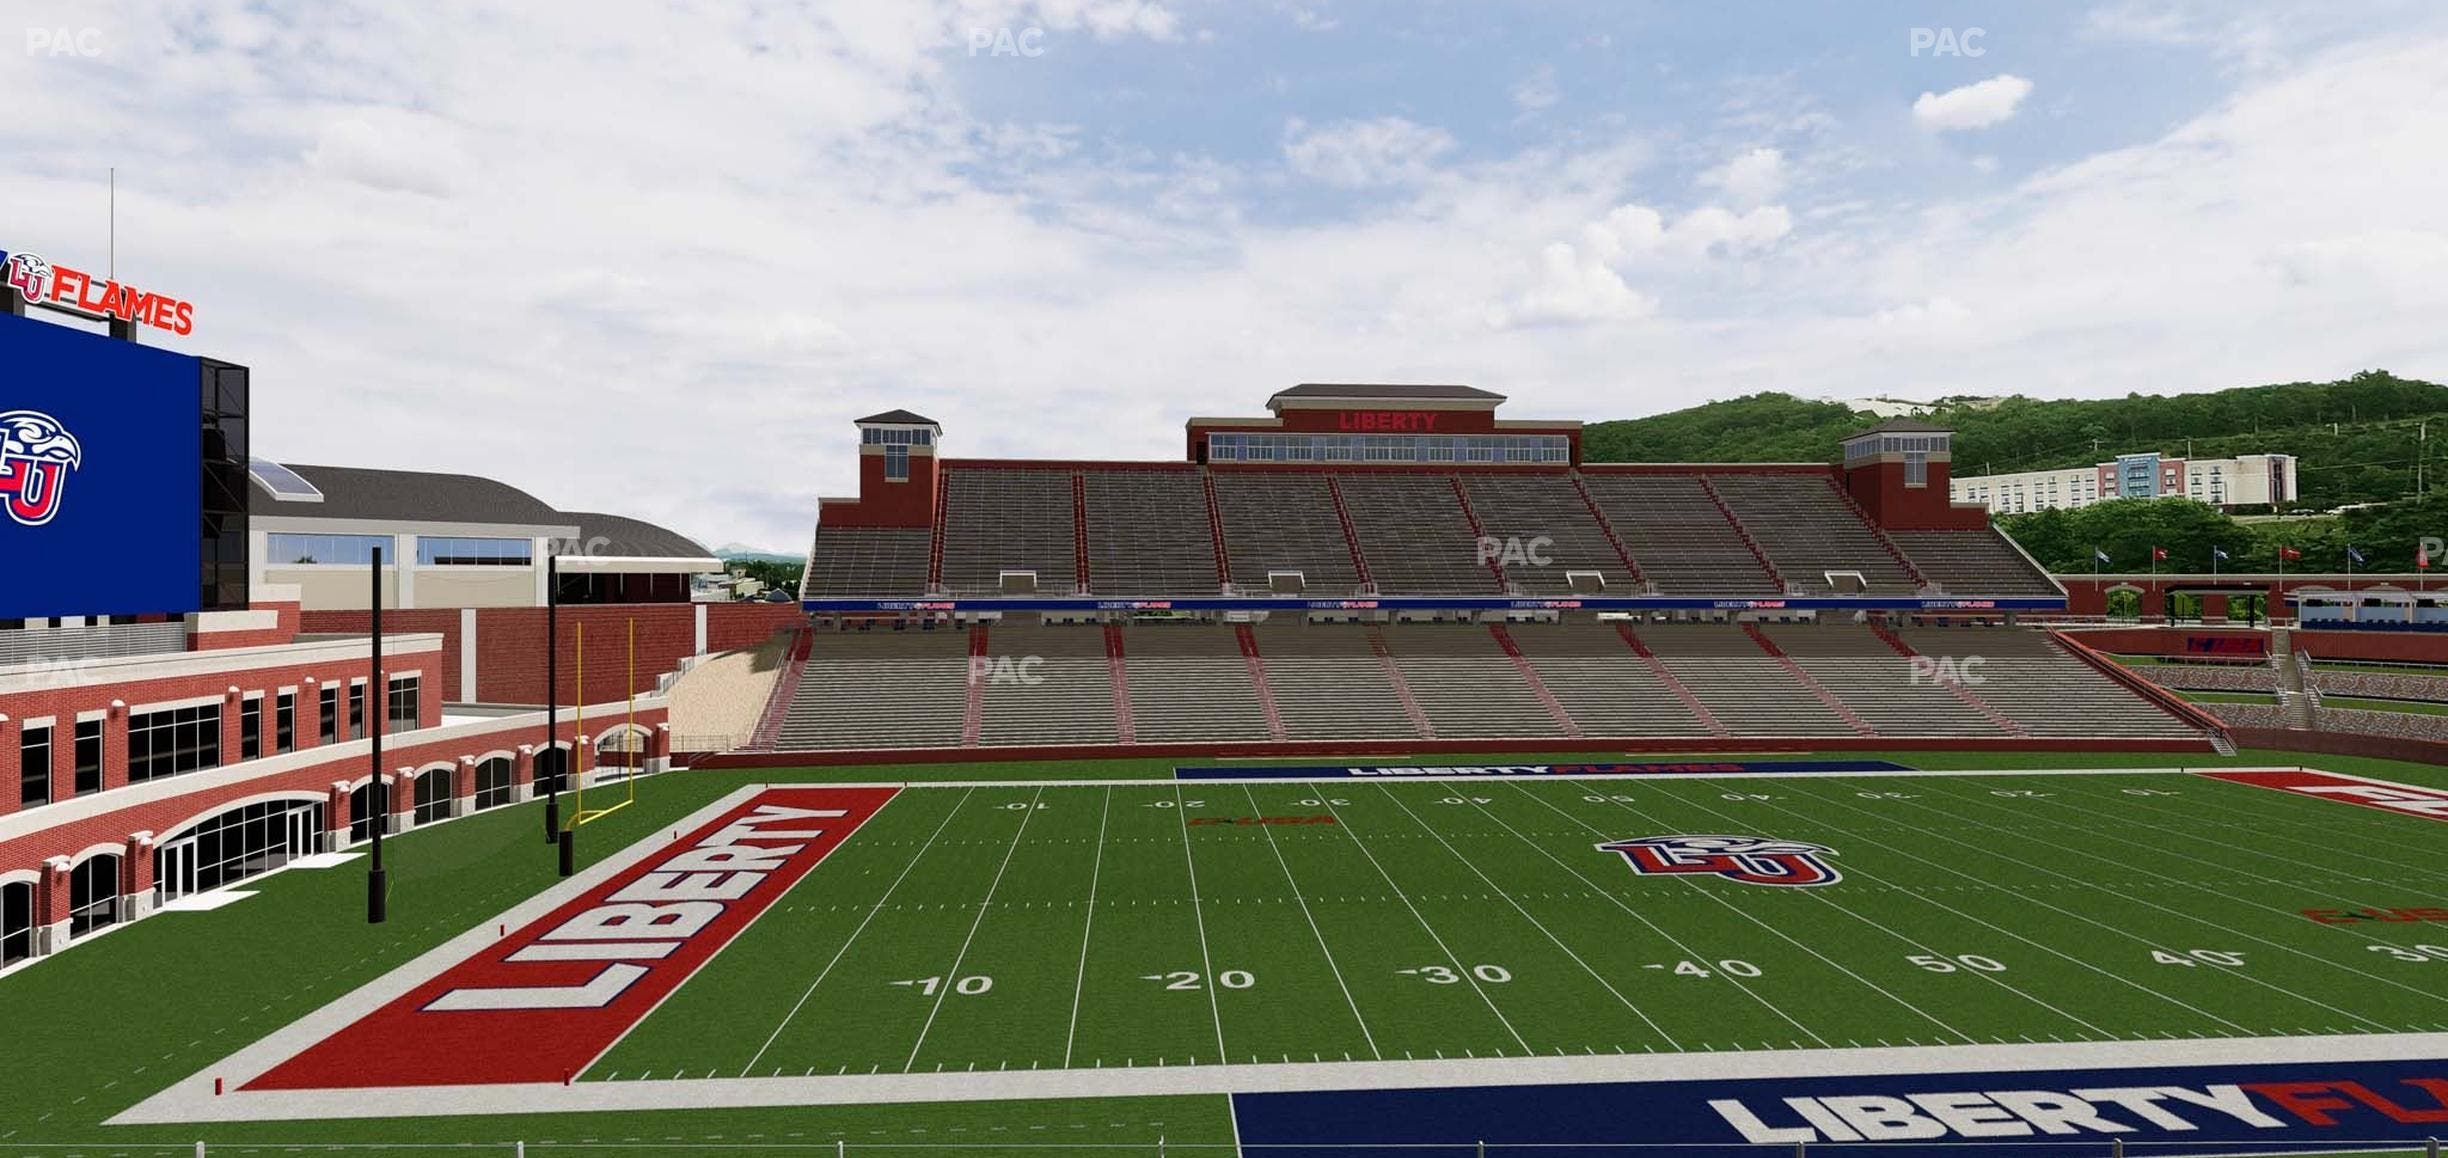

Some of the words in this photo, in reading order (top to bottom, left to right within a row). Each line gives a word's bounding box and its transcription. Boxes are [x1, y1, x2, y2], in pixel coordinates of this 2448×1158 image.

[50, 264, 194, 336] FLAMES
[1339, 412, 1438, 430] LIBERTY
[1347, 766, 1550, 776] LIBERTY
[417, 804, 850, 1013] LIBERTY
[1673, 958, 1762, 979] 40
[1906, 953, 2007, 974] 50
[2151, 949, 2245, 968] 40
[1165, 970, 1256, 991] 20
[1420, 964, 1513, 984] 30
[917, 975, 993, 996] 10
[1707, 1084, 2288, 1144] LIBERTY
